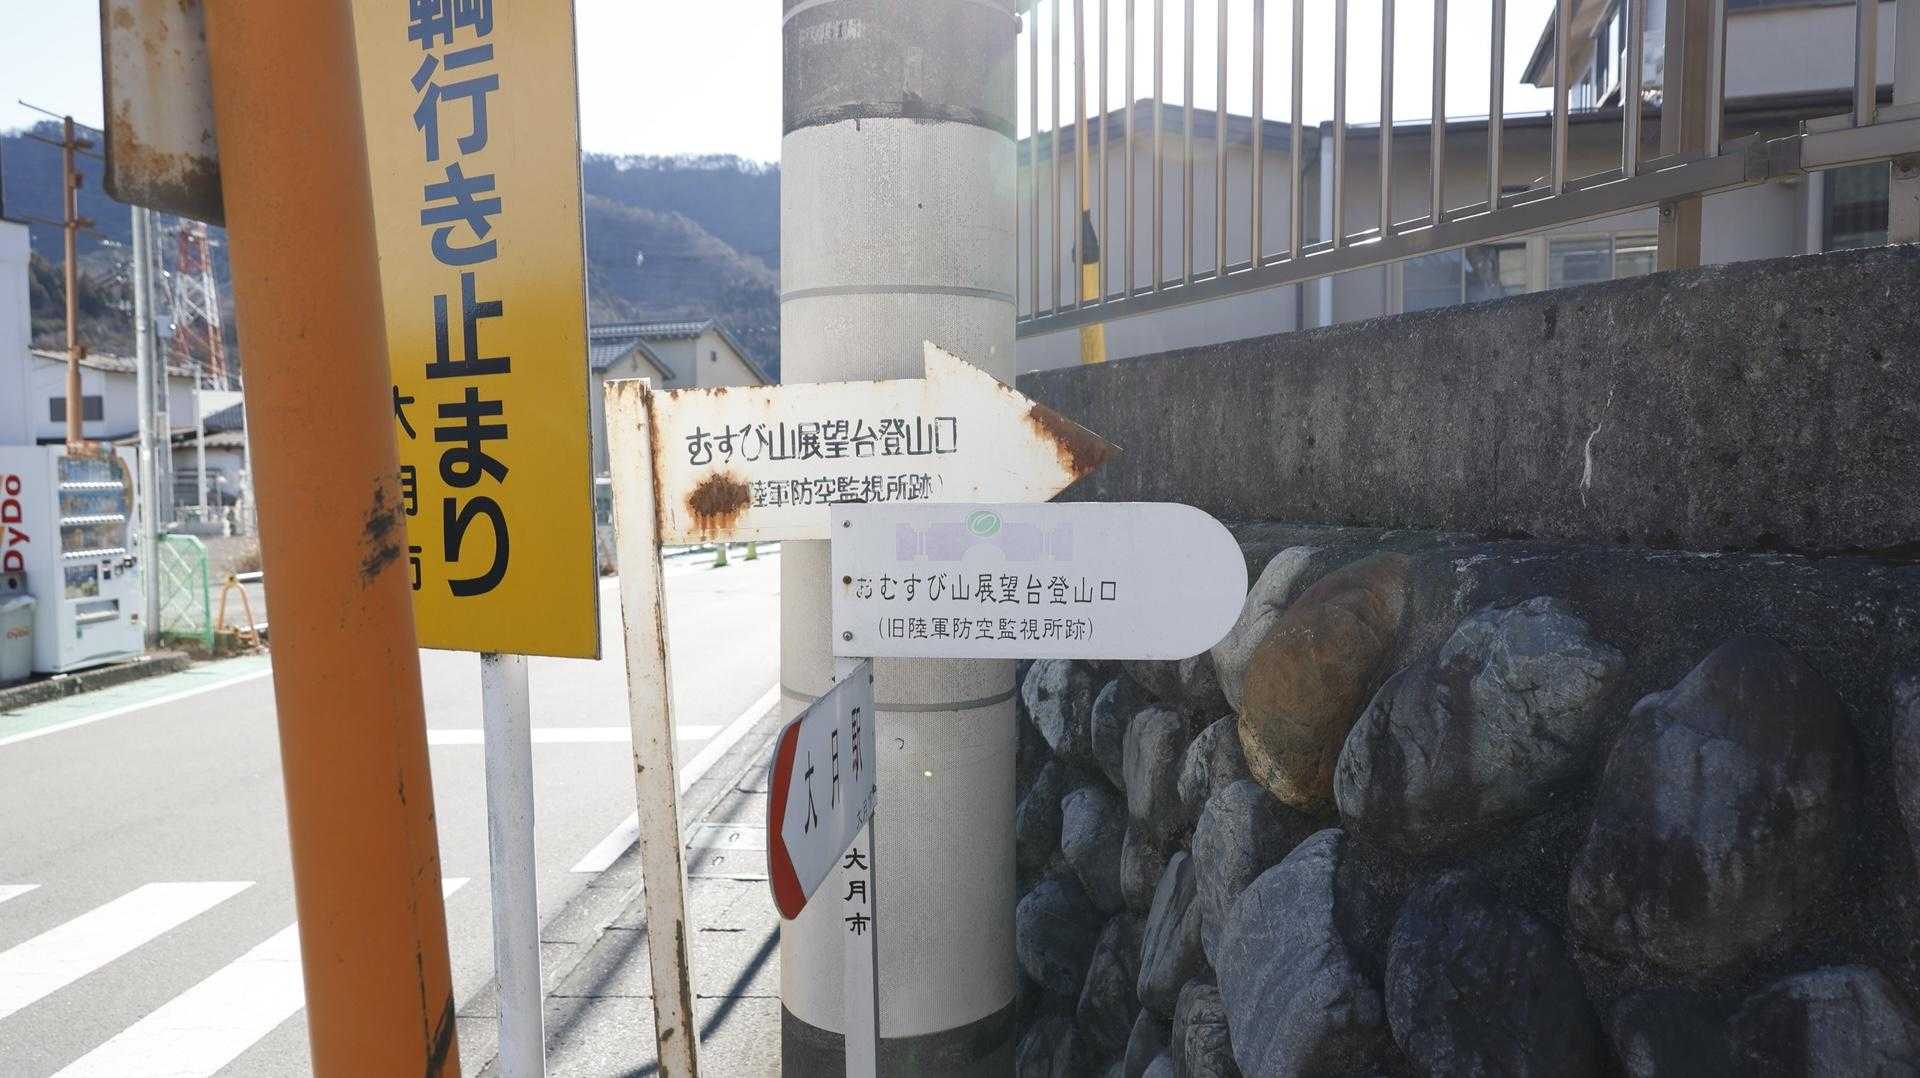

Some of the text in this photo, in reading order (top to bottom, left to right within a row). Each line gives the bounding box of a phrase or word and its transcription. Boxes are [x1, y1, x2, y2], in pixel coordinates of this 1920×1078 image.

[685, 416, 957, 466] むすび山展望台登山口
[1, 474, 31, 573] DyDo
[856, 572, 1117, 605] おむすび山展望台登山口
[878, 617, 1094, 641] (旧陸軍防空監視所跡)
[843, 848, 870, 936] 大月市
